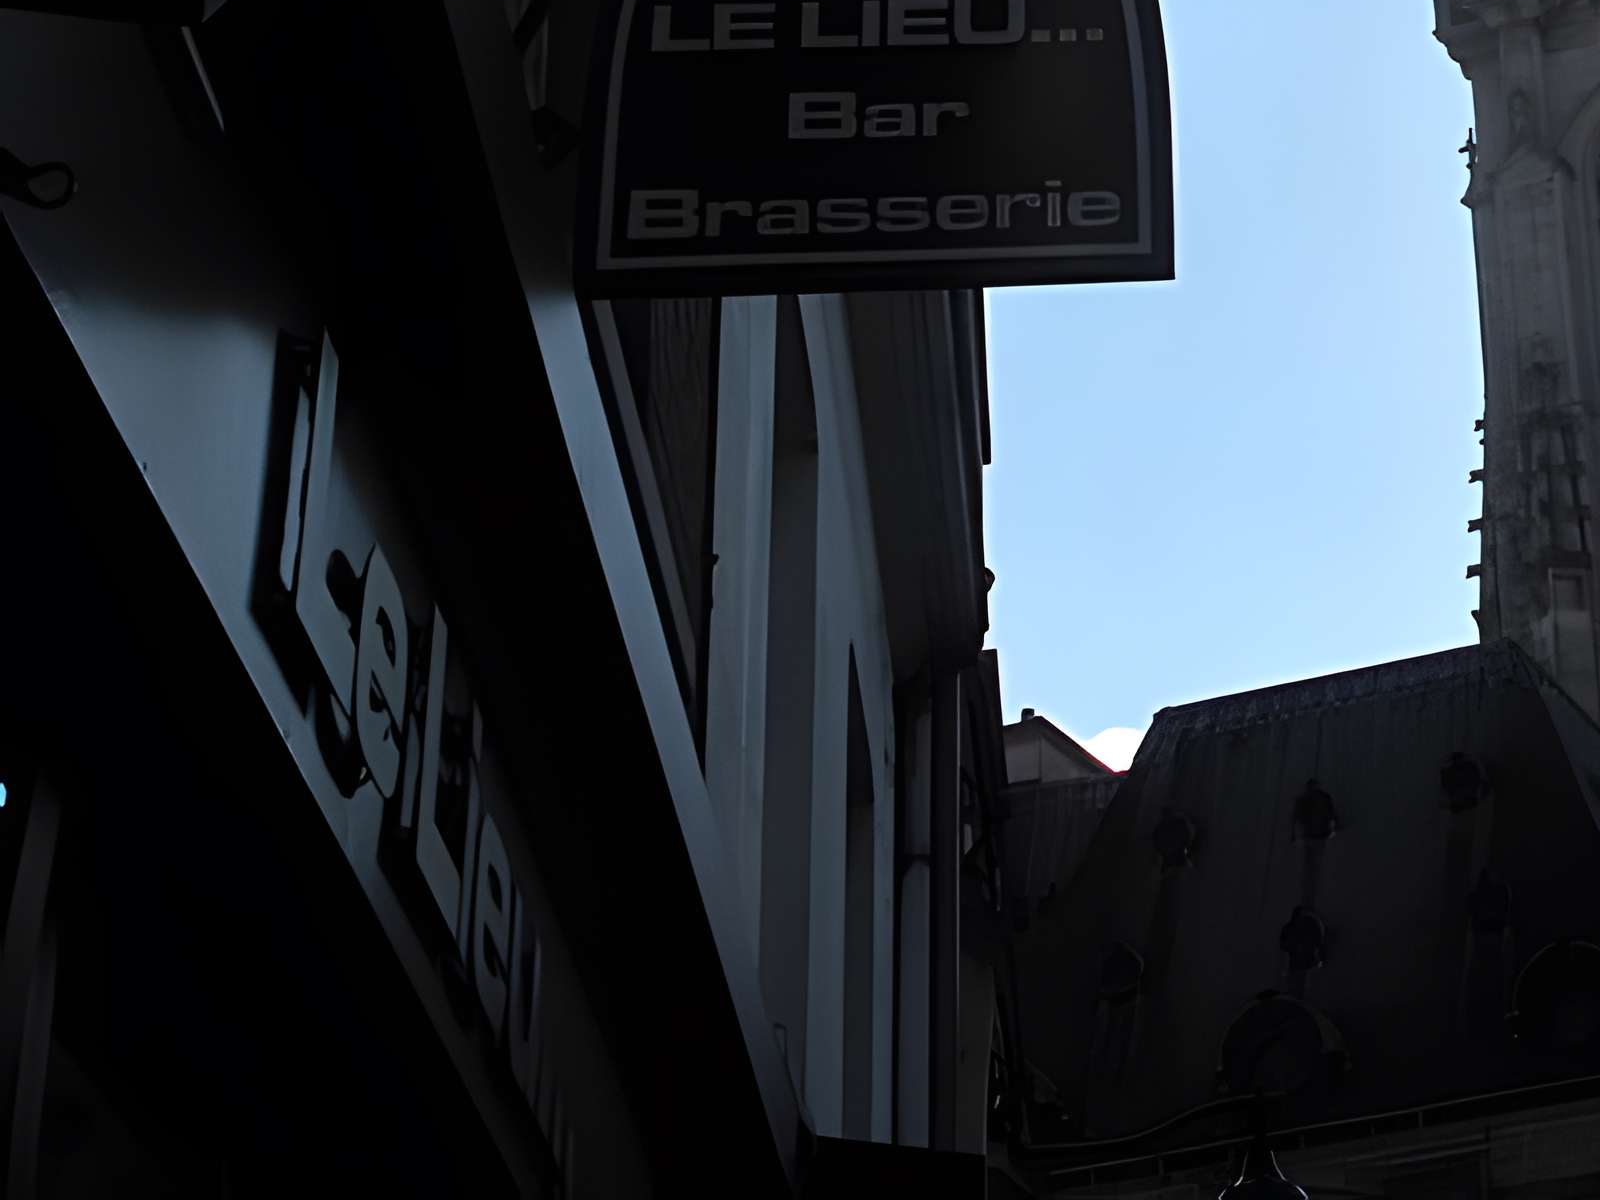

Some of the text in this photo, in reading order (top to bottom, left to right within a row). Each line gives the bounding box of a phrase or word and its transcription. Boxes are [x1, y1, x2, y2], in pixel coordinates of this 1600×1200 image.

[650, 1, 777, 53] LE
[786, 90, 971, 140] Bar
[625, 179, 1122, 240] Brasserie
